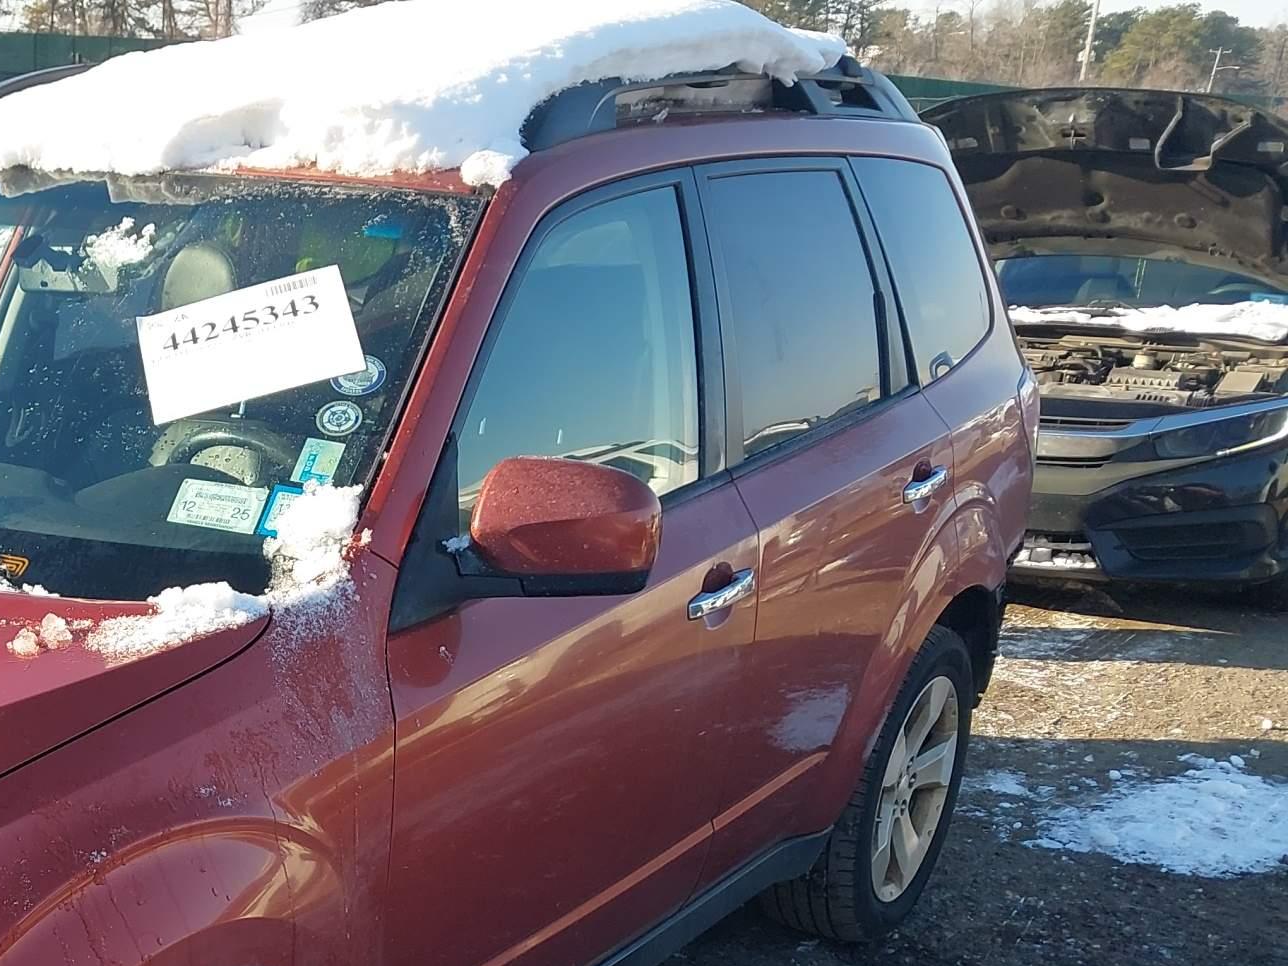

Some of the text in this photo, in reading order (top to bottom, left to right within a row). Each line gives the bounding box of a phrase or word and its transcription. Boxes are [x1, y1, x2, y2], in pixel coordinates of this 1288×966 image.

[163, 295, 319, 350] 44245343
[181, 500, 197, 513] 12
[231, 507, 252, 521] 25
